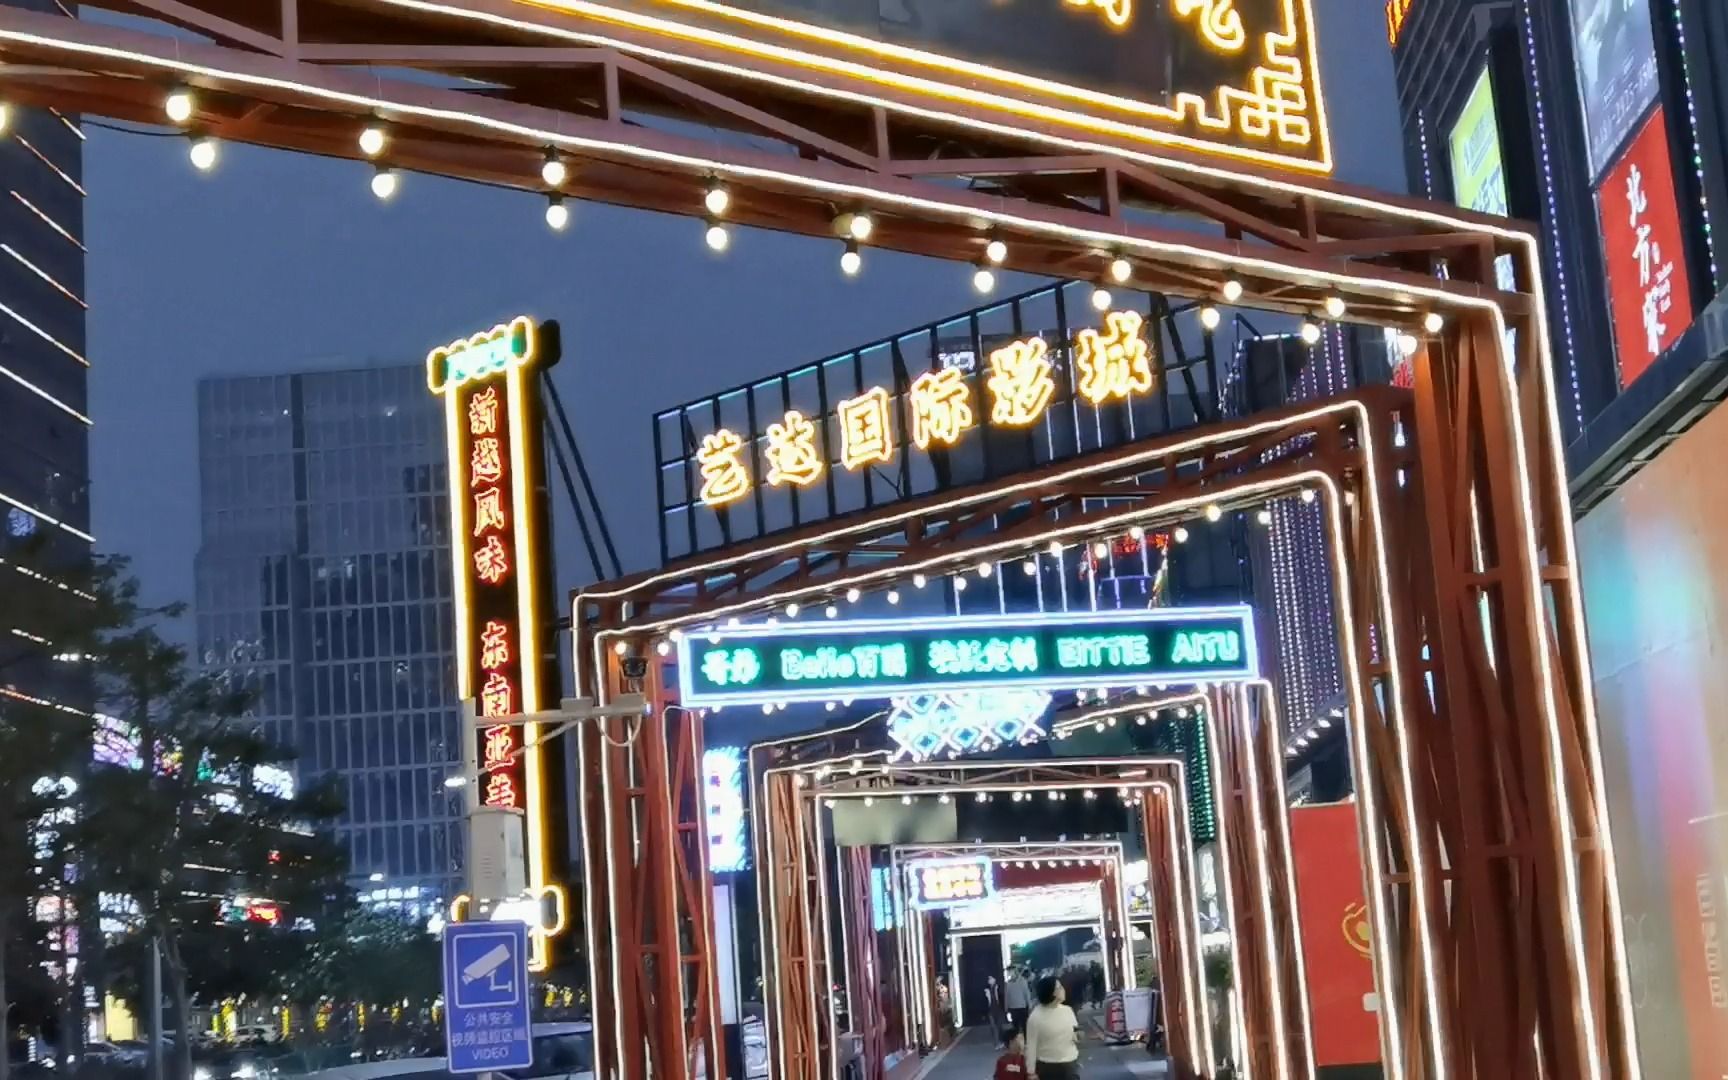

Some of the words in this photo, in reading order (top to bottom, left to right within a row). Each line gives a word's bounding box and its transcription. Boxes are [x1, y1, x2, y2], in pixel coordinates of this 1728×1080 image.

[464, 1011, 514, 1028] 公共安全
[471, 1047, 510, 1061] VIDEO
